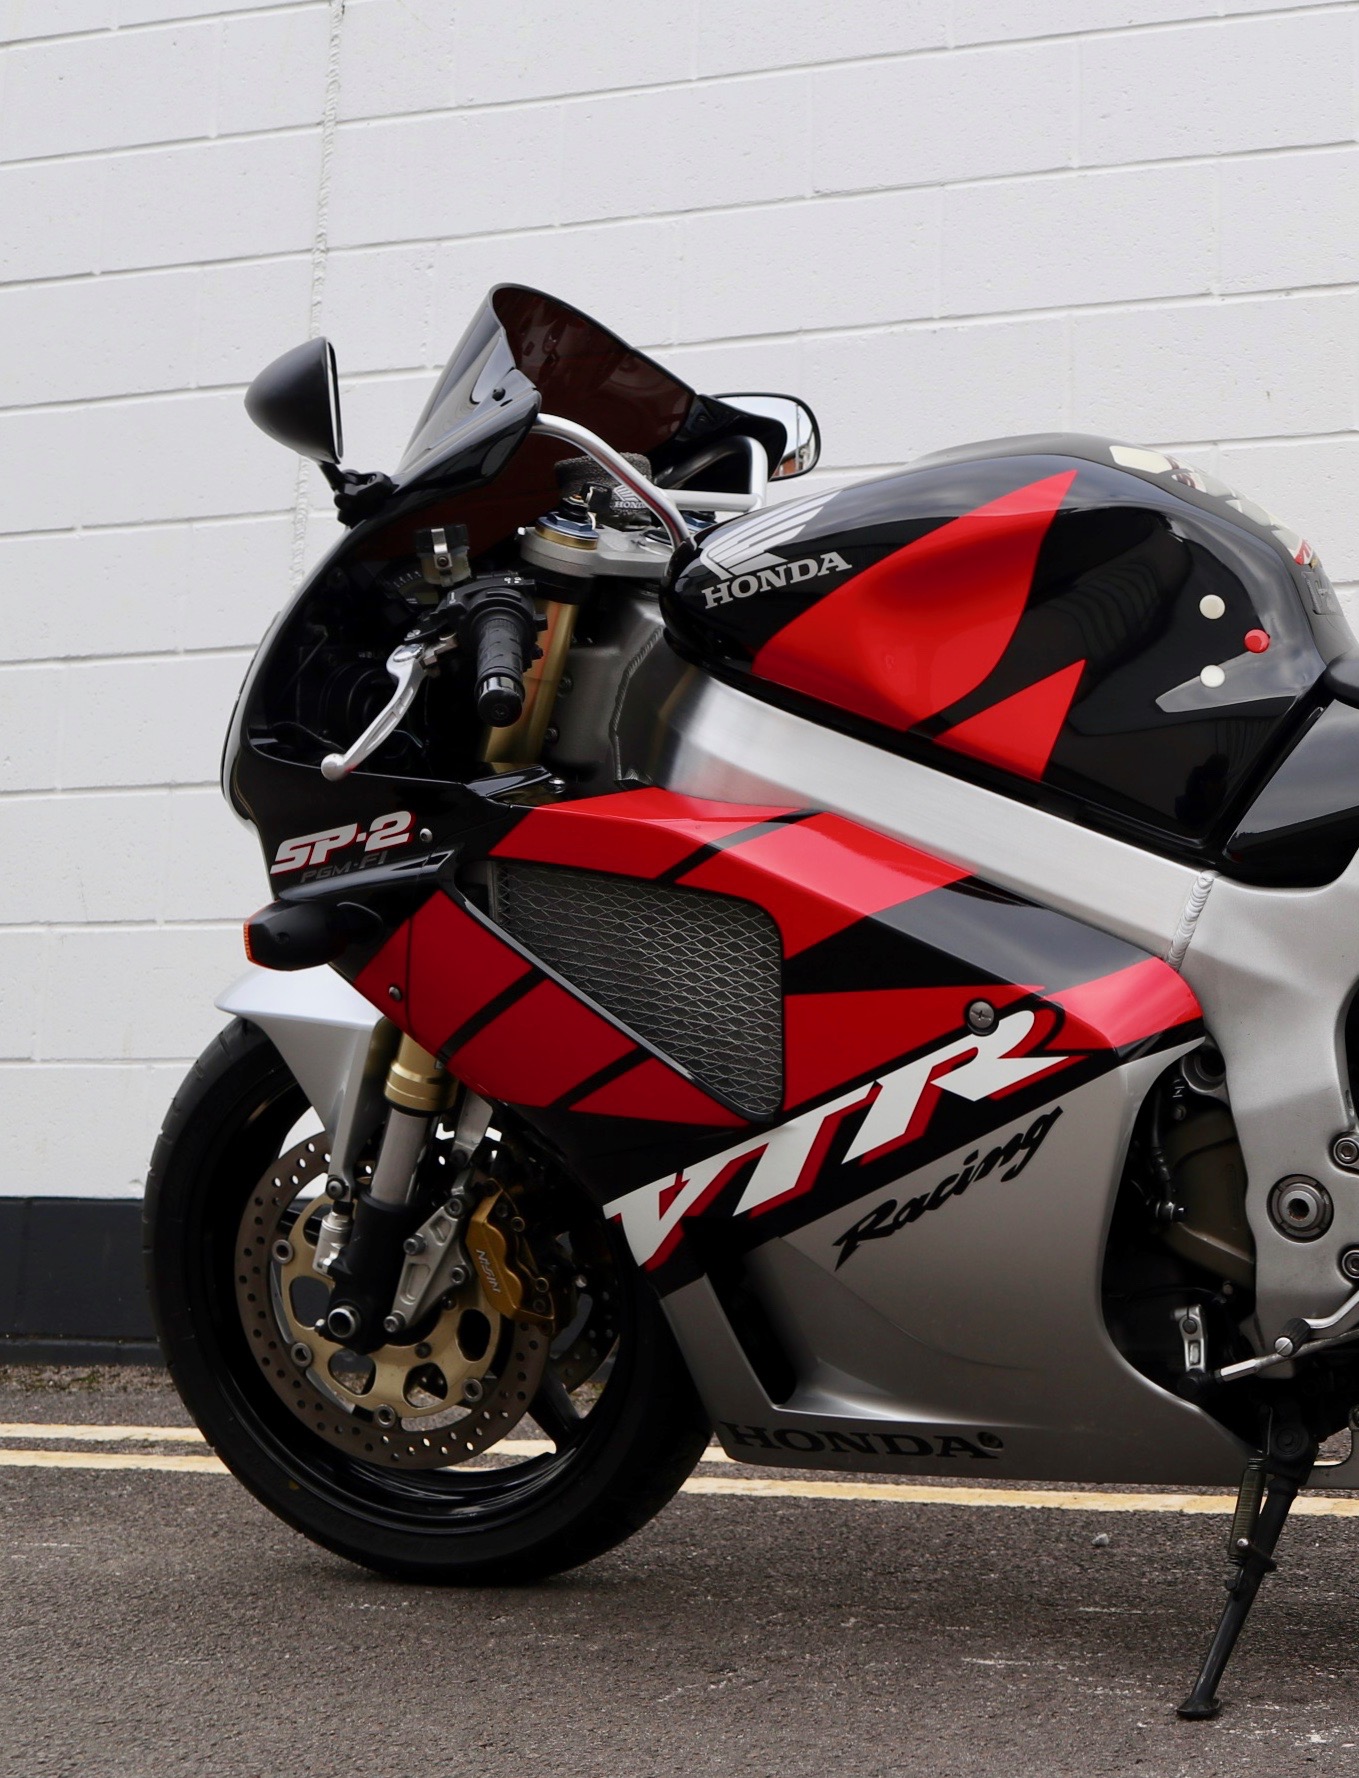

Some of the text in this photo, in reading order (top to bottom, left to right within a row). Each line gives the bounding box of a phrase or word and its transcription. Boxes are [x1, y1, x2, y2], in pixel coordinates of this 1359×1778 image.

[701, 551, 853, 610] HONDA
[270, 810, 416, 876] SP-2
[300, 850, 389, 884] PGM-FI
[602, 1008, 1088, 1272] VTR
[832, 1106, 1064, 1263] Racing
[719, 1420, 999, 1459] HONDA
